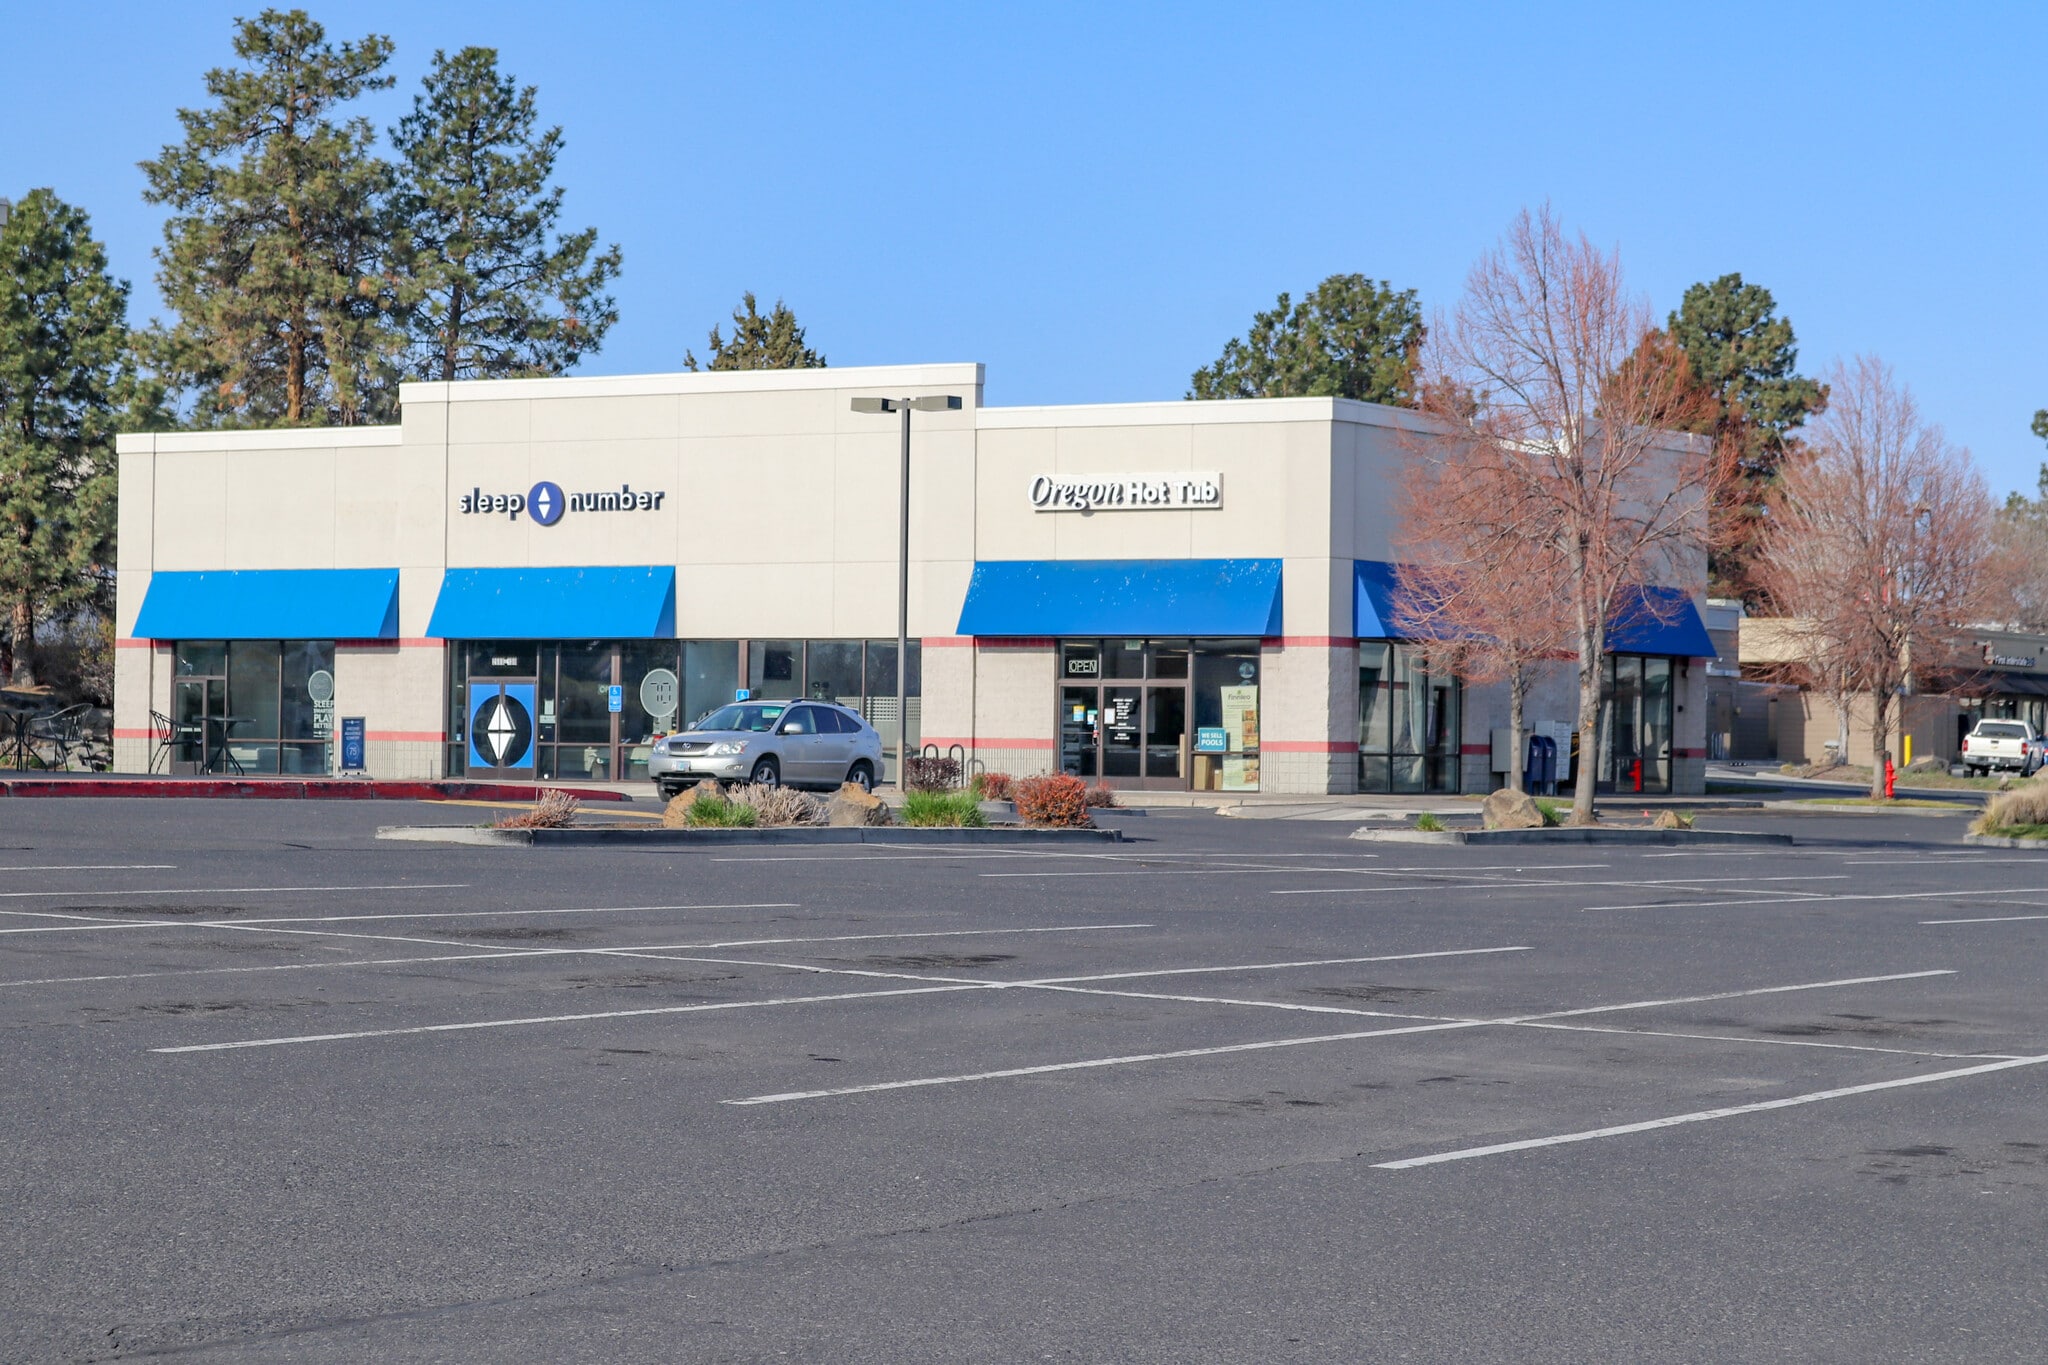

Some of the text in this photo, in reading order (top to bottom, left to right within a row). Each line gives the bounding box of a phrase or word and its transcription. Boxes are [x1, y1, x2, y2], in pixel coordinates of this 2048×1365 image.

[458, 484, 665, 521] sleep number
[1028, 474, 1219, 516] Oregon Hot Tub
[1069, 661, 1097, 672] OPEN
[313, 714, 334, 723] PLAY
